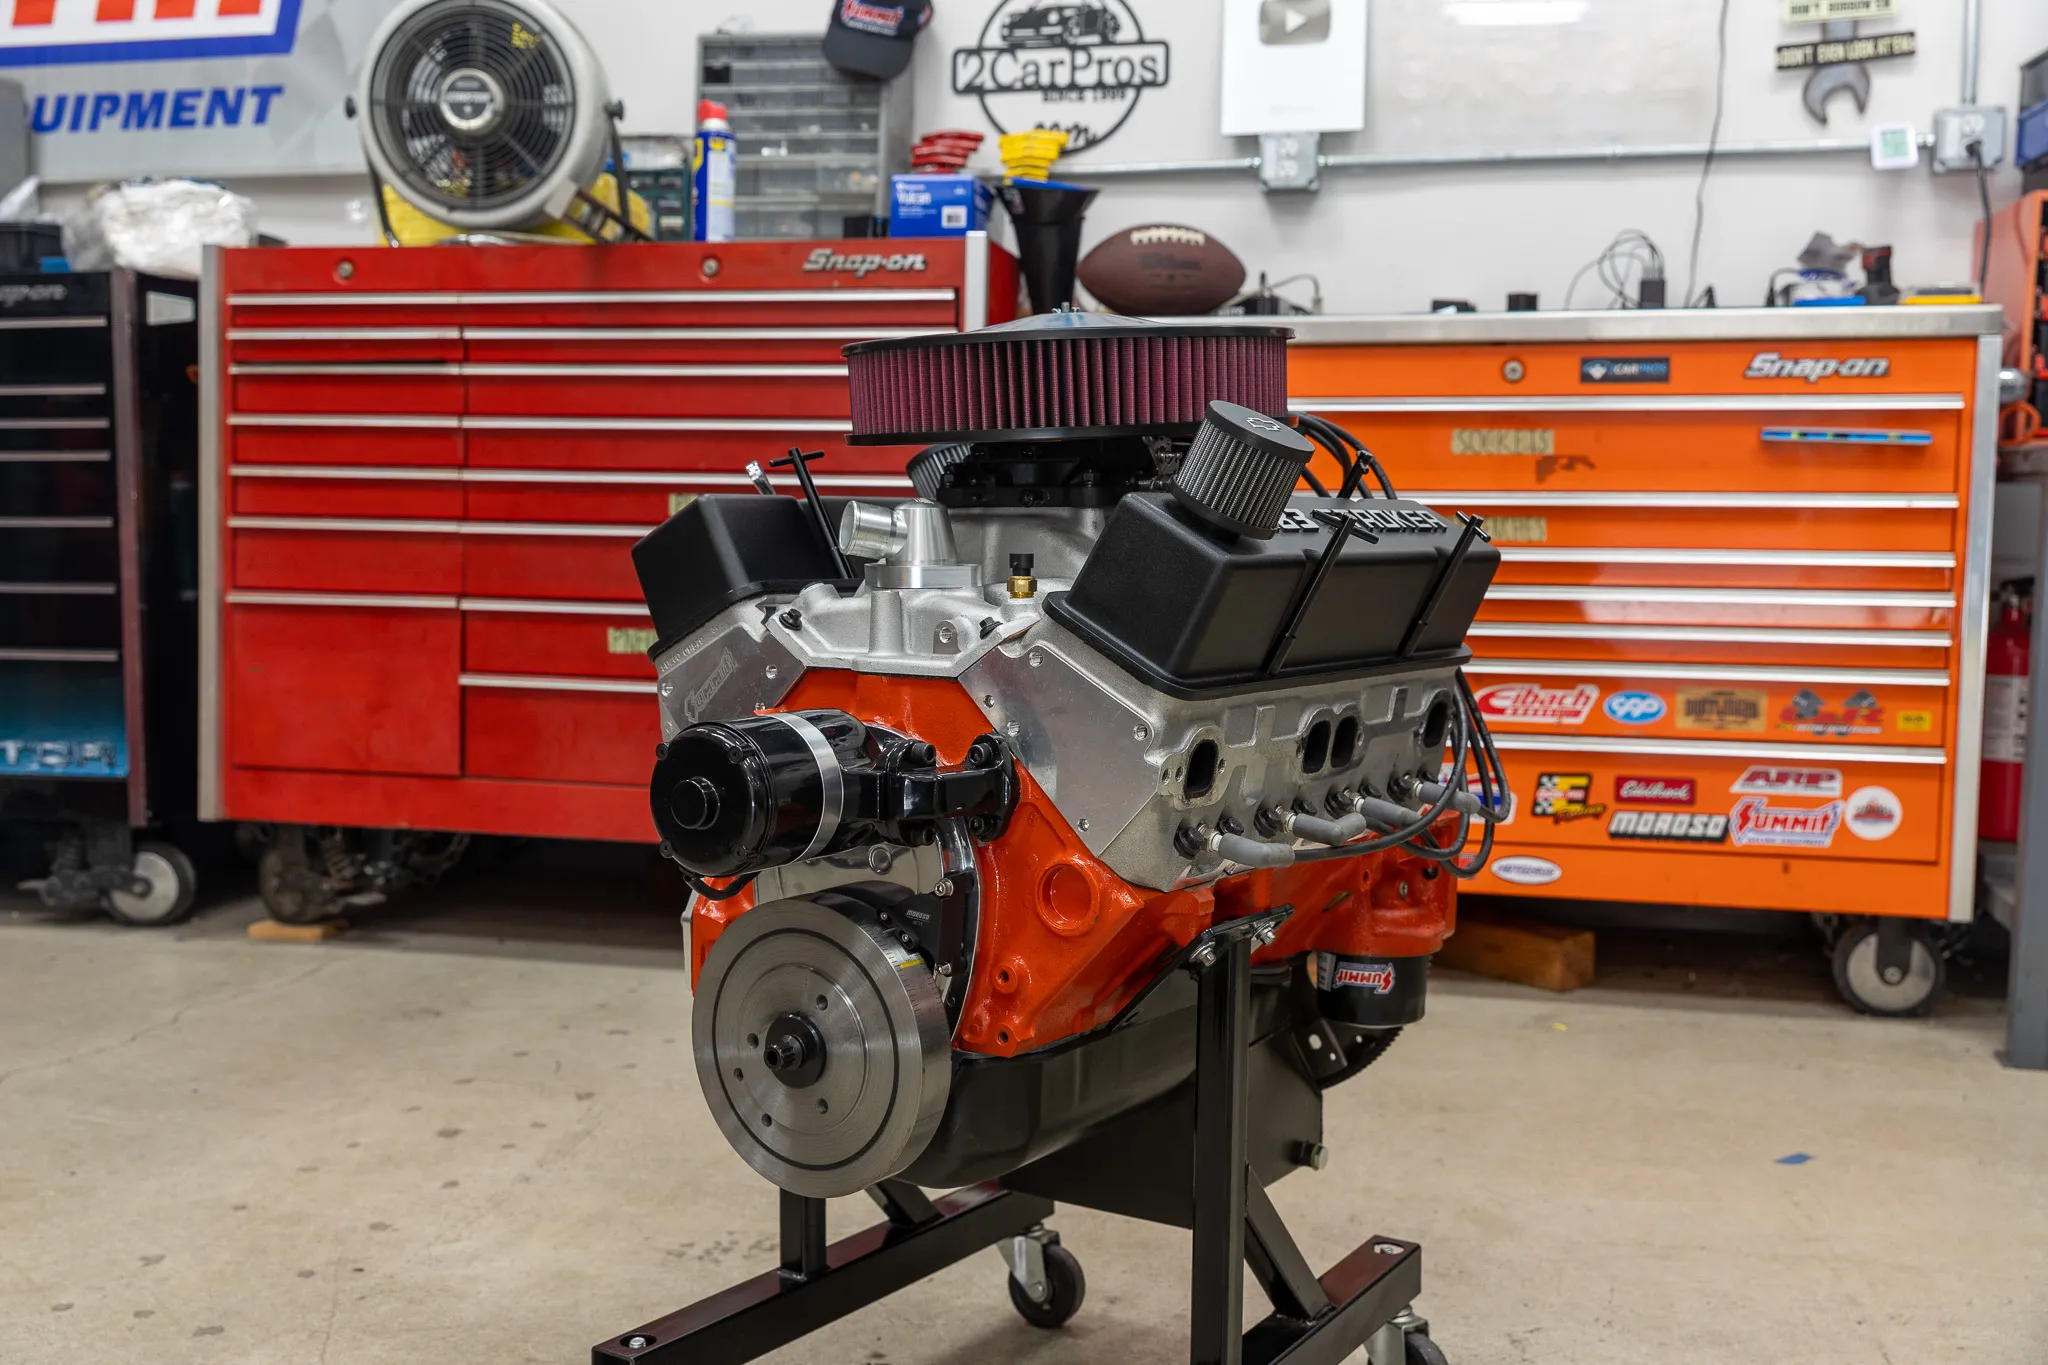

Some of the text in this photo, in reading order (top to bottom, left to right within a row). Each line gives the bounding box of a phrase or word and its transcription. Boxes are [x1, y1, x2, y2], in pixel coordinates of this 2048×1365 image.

[962, 48, 1160, 93] 2CarPros
[28, 84, 284, 134] UIPMENT
[802, 247, 927, 278] Snap-on
[1744, 351, 1889, 382] Snap-on
[1278, 508, 1319, 532] 83
[1479, 682, 1592, 715] Eibach
[1745, 770, 1836, 787] ARP
[1608, 811, 1728, 840] MOROSO
